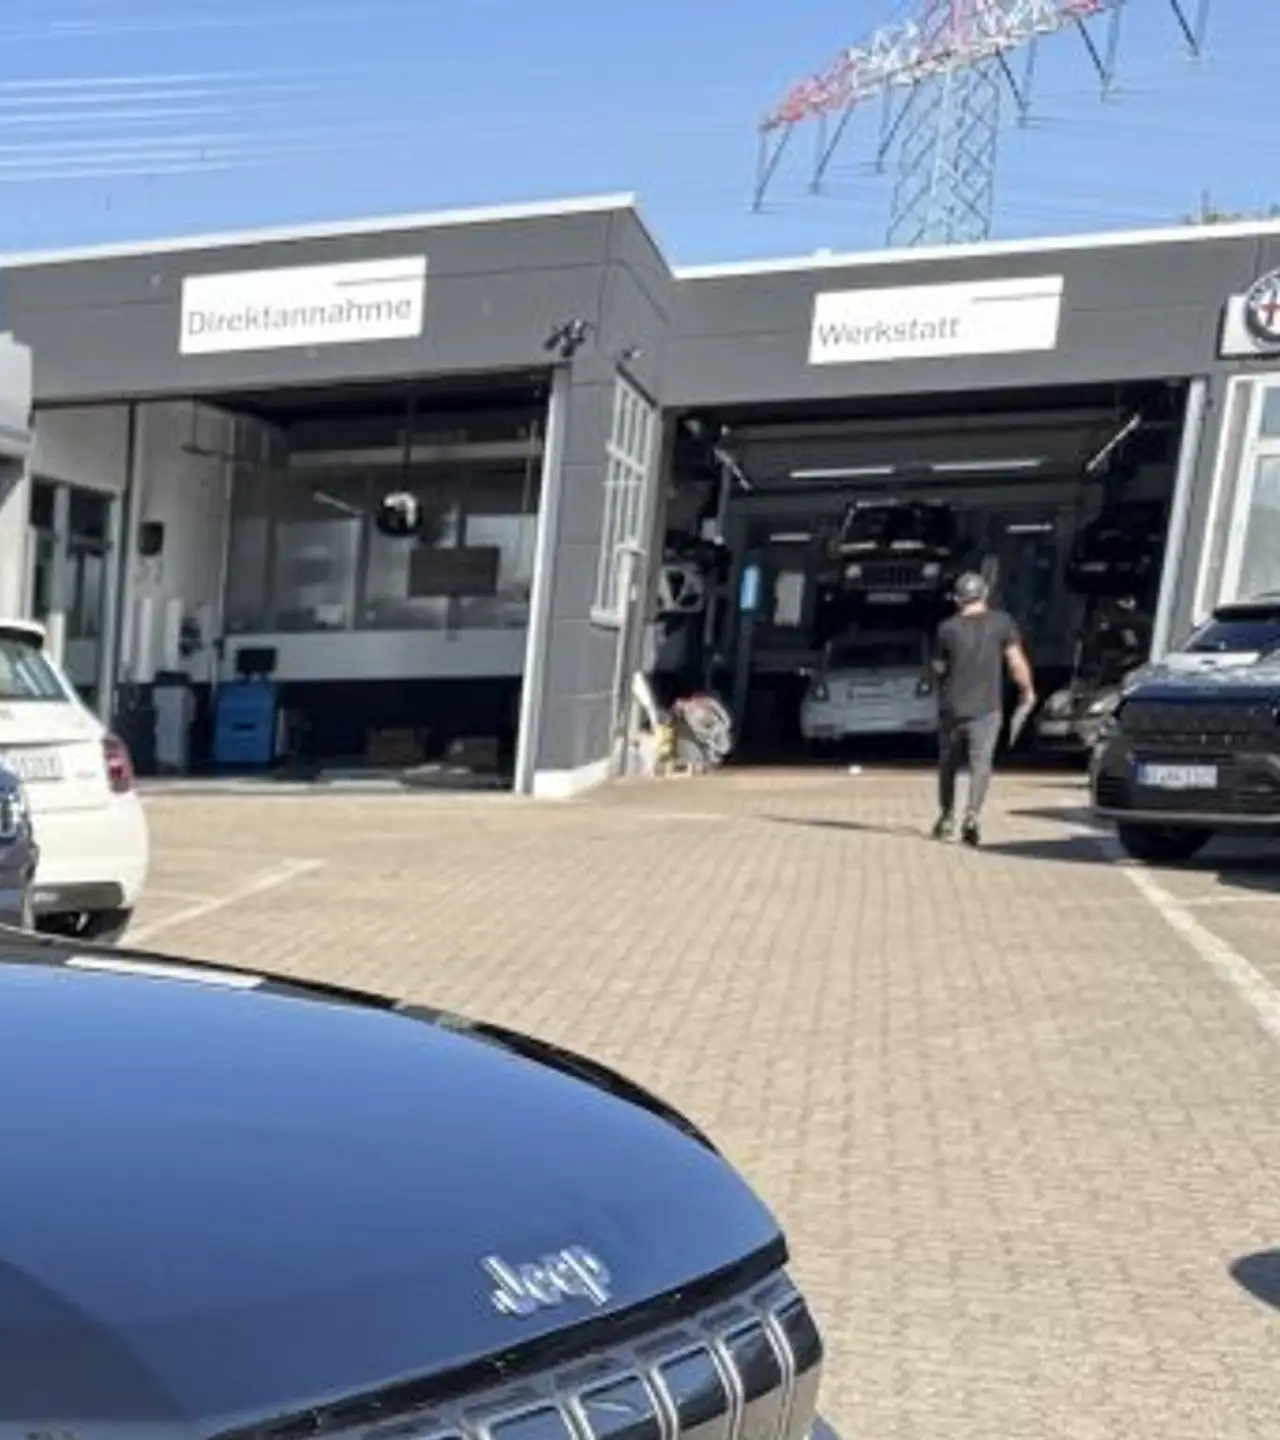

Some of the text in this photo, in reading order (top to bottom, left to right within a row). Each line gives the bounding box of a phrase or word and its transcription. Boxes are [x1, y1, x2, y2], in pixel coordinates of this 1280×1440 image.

[188, 299, 412, 336] Direktannahme
[817, 314, 961, 348] Werkstatt
[481, 1245, 612, 1315] Jeep
